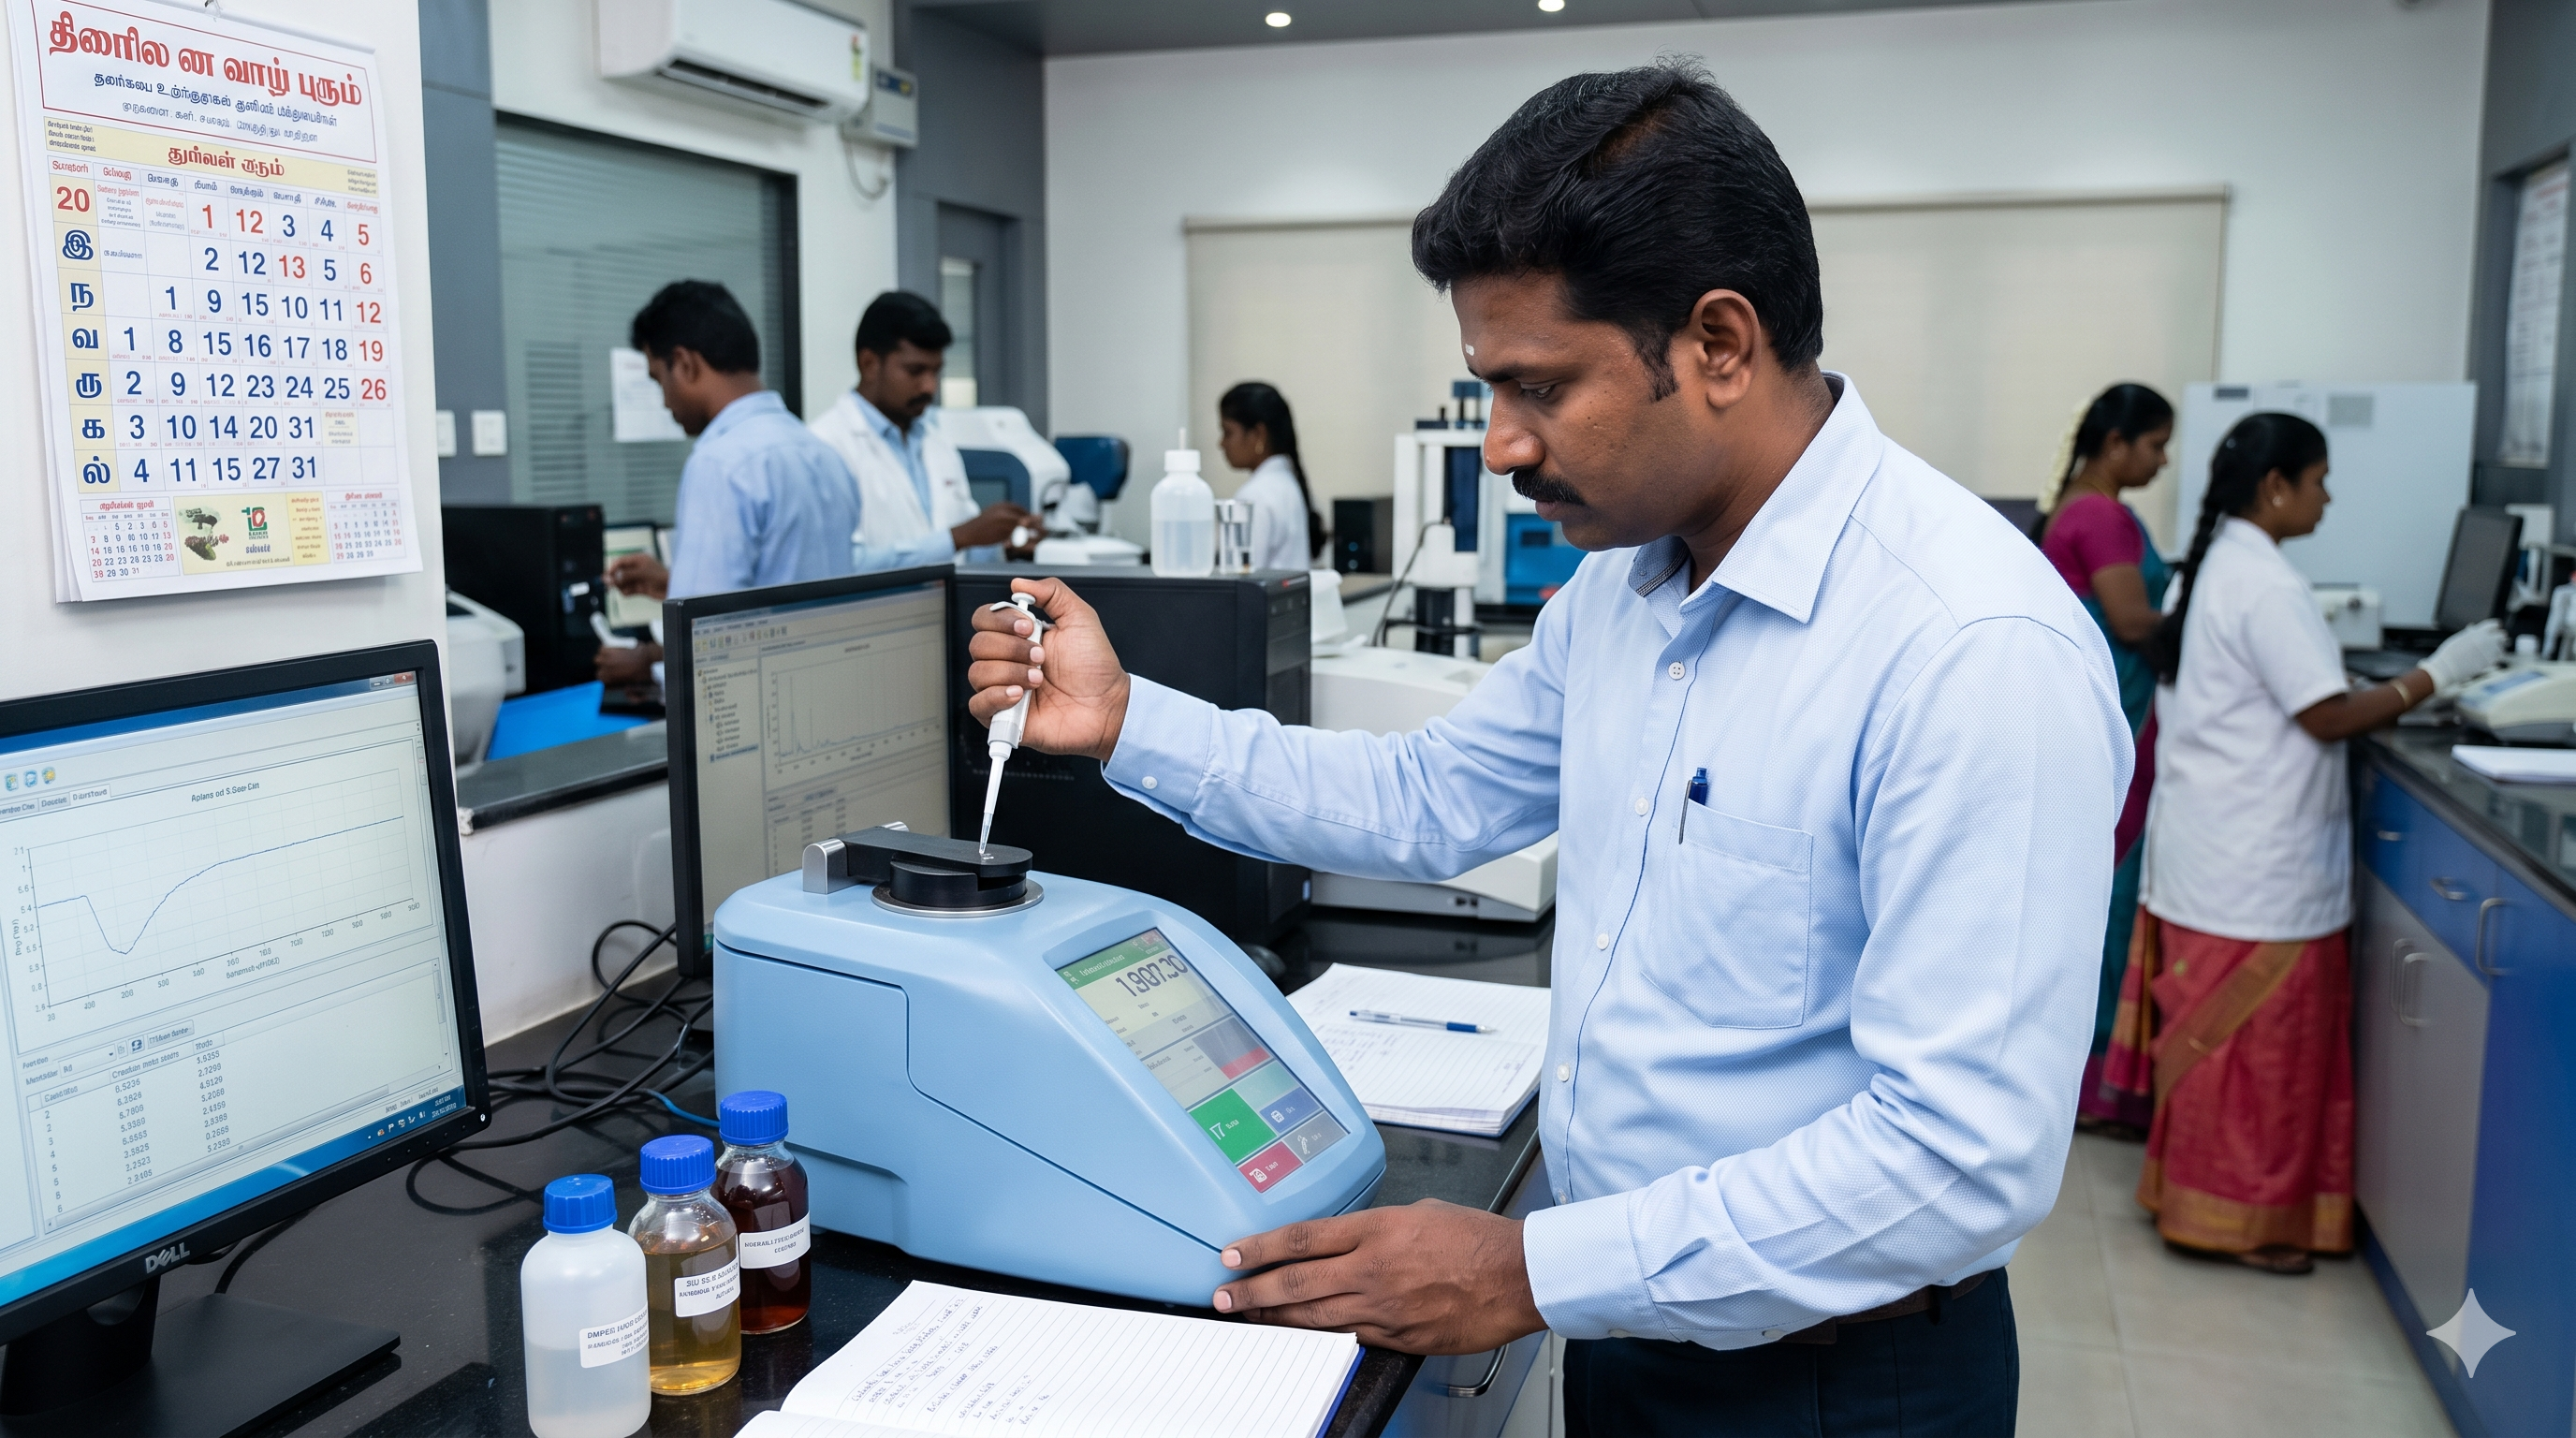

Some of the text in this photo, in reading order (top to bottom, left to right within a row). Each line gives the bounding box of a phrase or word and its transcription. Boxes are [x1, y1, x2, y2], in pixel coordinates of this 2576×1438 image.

[57, 186, 89, 212] 20
[203, 205, 212, 228] 1
[237, 209, 263, 233] 12
[283, 215, 295, 237] 3
[321, 220, 333, 242] 4
[359, 224, 369, 245] 5
[205, 247, 372, 284] 2 12 13 5 6
[71, 283, 94, 311] ந
[166, 286, 381, 323] 1 9 15 10 11 12
[72, 329, 98, 348] வ
[124, 327, 383, 361] 1 8 15 16 17 18 19
[126, 371, 386, 400] 2 9 12 23 24 25 26
[82, 419, 105, 438] க
[130, 415, 144, 439] 3
[168, 416, 196, 439] 10
[210, 416, 238, 438] 14
[250, 417, 277, 439] 20
[289, 417, 313, 438] 31
[83, 456, 110, 483] ல்
[134, 457, 315, 482] 4 11 15 27 31
[45, 1110, 50, 1119] 2
[145, 1241, 190, 1274] DELL
